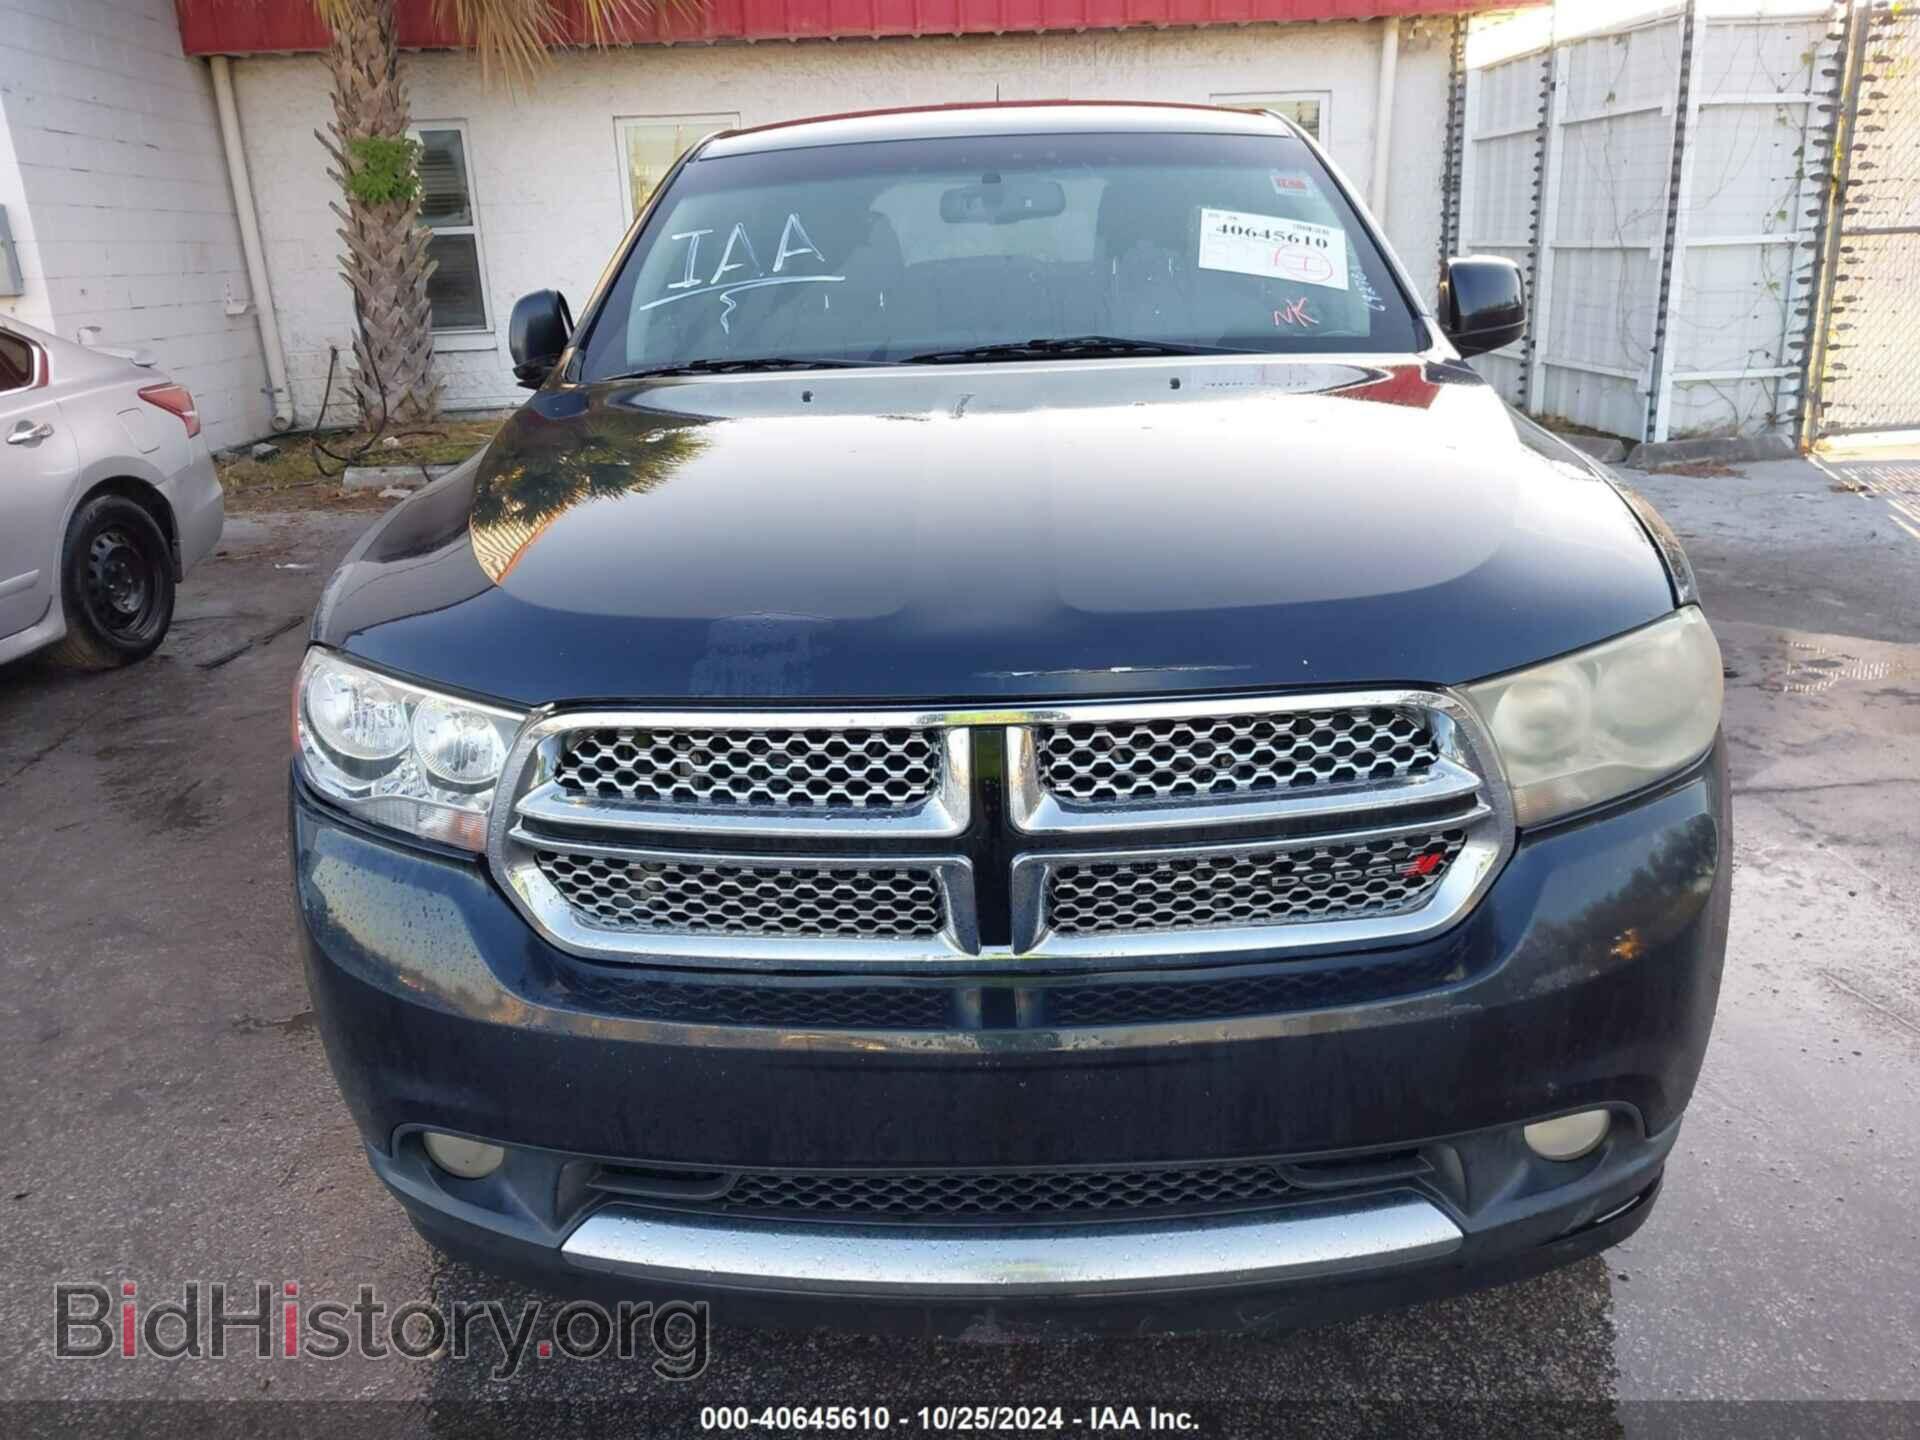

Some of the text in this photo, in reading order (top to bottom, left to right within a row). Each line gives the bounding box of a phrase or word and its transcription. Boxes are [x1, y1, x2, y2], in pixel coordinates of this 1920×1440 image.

[1216, 223, 1329, 249] 40645610
[668, 213, 825, 288] IAA
[1271, 861, 1420, 888] DODGE
